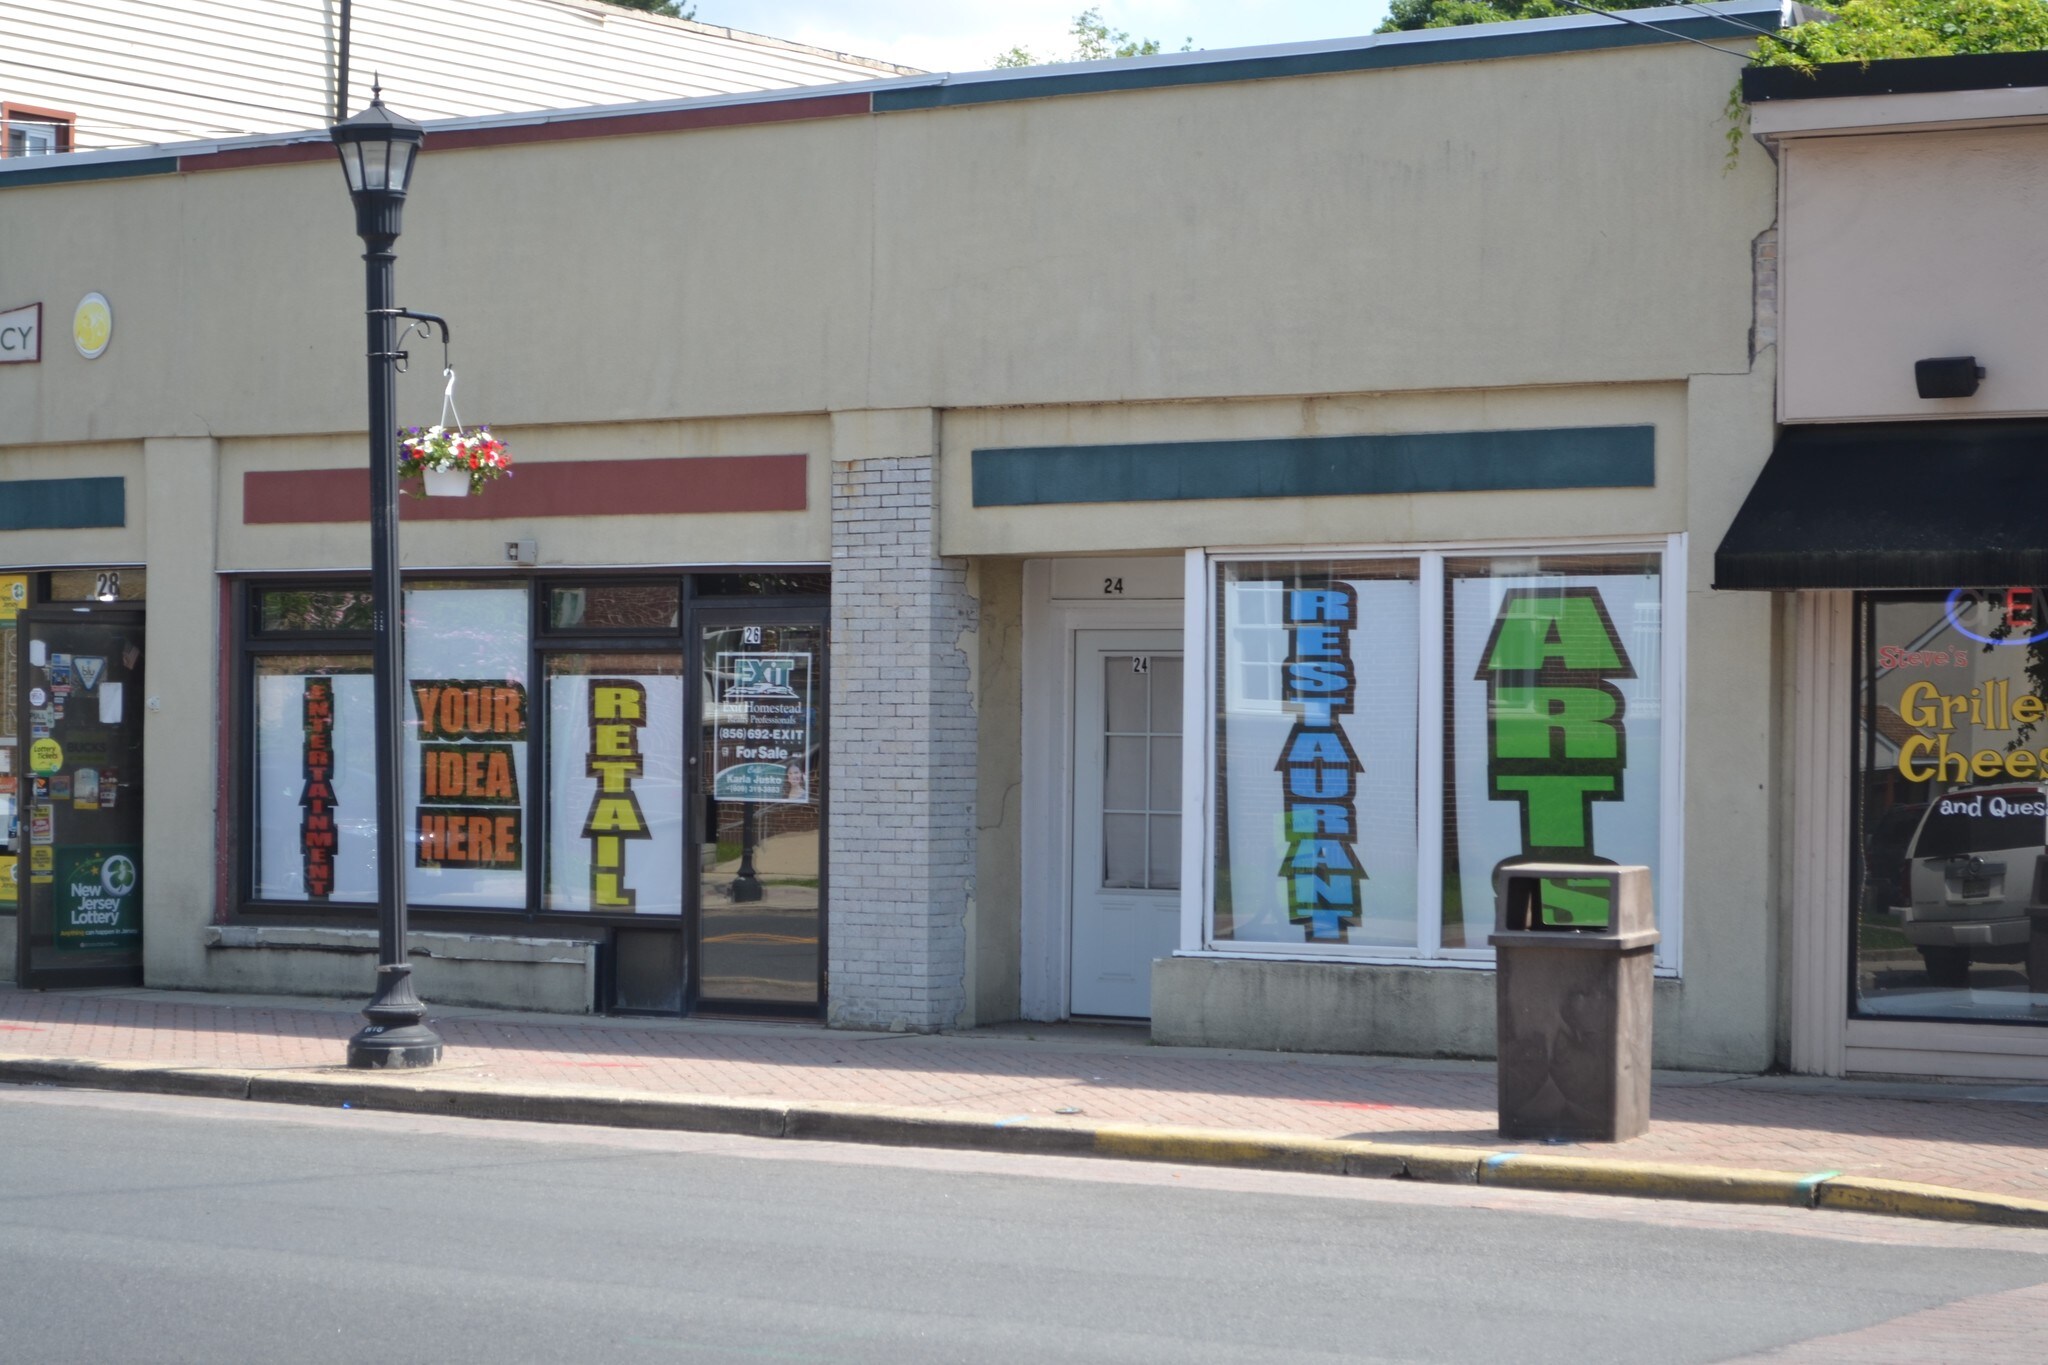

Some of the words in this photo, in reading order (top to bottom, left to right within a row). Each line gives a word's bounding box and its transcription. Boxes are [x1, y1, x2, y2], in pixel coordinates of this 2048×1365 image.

[97, 573, 119, 596] 28
[1104, 577, 1124, 594] 24
[745, 627, 759, 643] 26
[1133, 657, 1148, 673] 24
[1878, 645, 1968, 669] Steve's
[416, 687, 521, 734] YOUR
[722, 701, 742, 713] Exit
[745, 701, 802, 714] Homestead
[1900, 677, 2048, 731] Grille
[750, 715, 796, 724] Professionals
[34, 746, 56, 755] Lottery
[37, 752, 58, 760] Tickets
[736, 746, 757, 759] For
[758, 746, 789, 759] Sale
[1284, 587, 1356, 940] RESTAURANT
[425, 751, 513, 797] IDEA
[304, 681, 335, 897] ENTERTAINMENT
[588, 684, 644, 907] RETAIL
[1940, 795, 1982, 817] and
[1990, 797, 2048, 818] Ques
[421, 815, 516, 862] HERE
[71, 883, 101, 897] New
[78, 898, 120, 912] Jersey
[71, 910, 119, 926] Lottery
